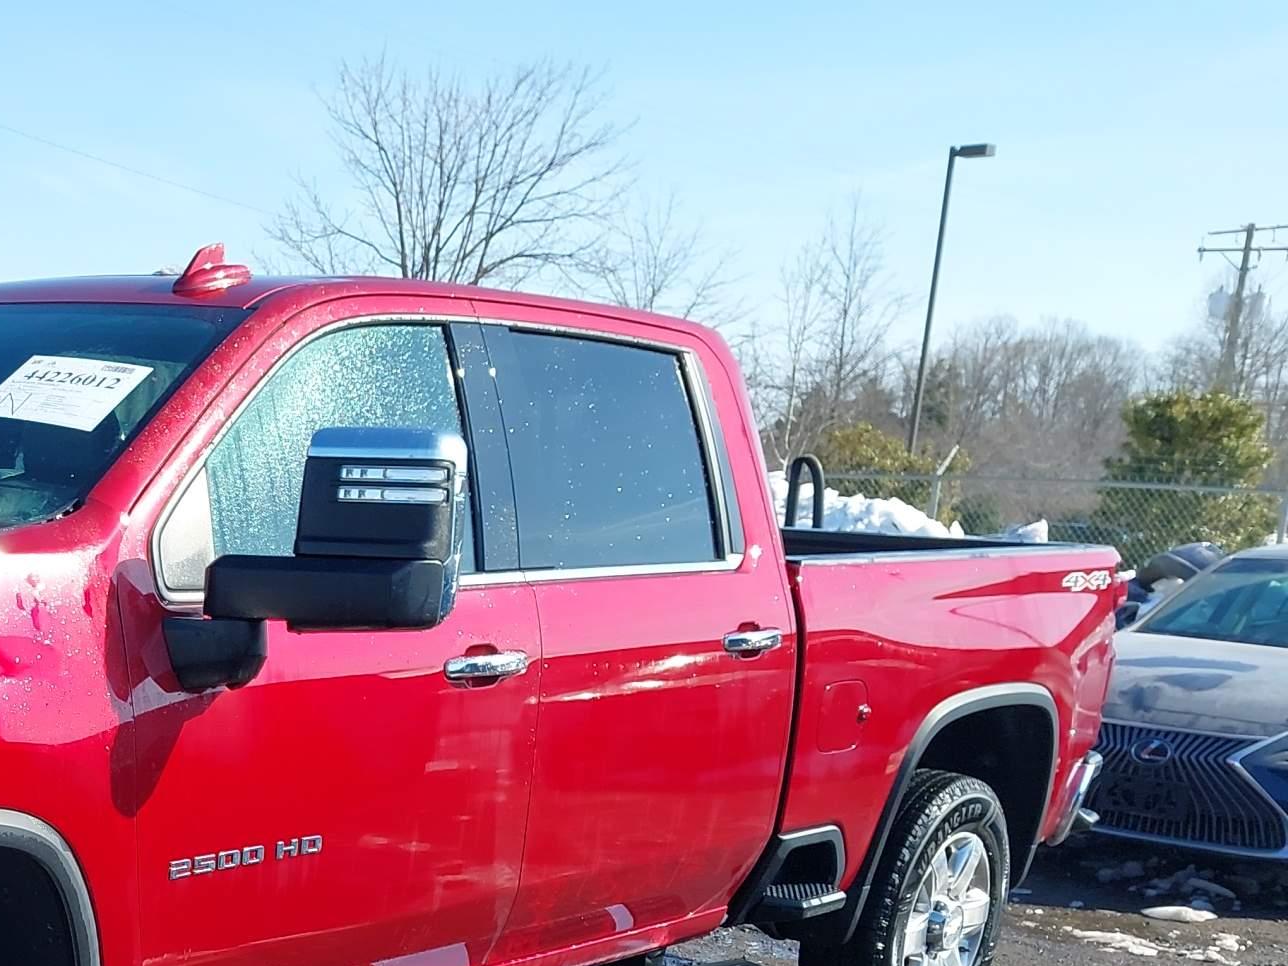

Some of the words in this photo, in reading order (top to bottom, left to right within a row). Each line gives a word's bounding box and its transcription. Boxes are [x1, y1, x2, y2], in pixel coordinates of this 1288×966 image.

[24, 370, 121, 389] 44226012
[169, 845, 265, 880] 2500
[275, 835, 323, 860] HD
